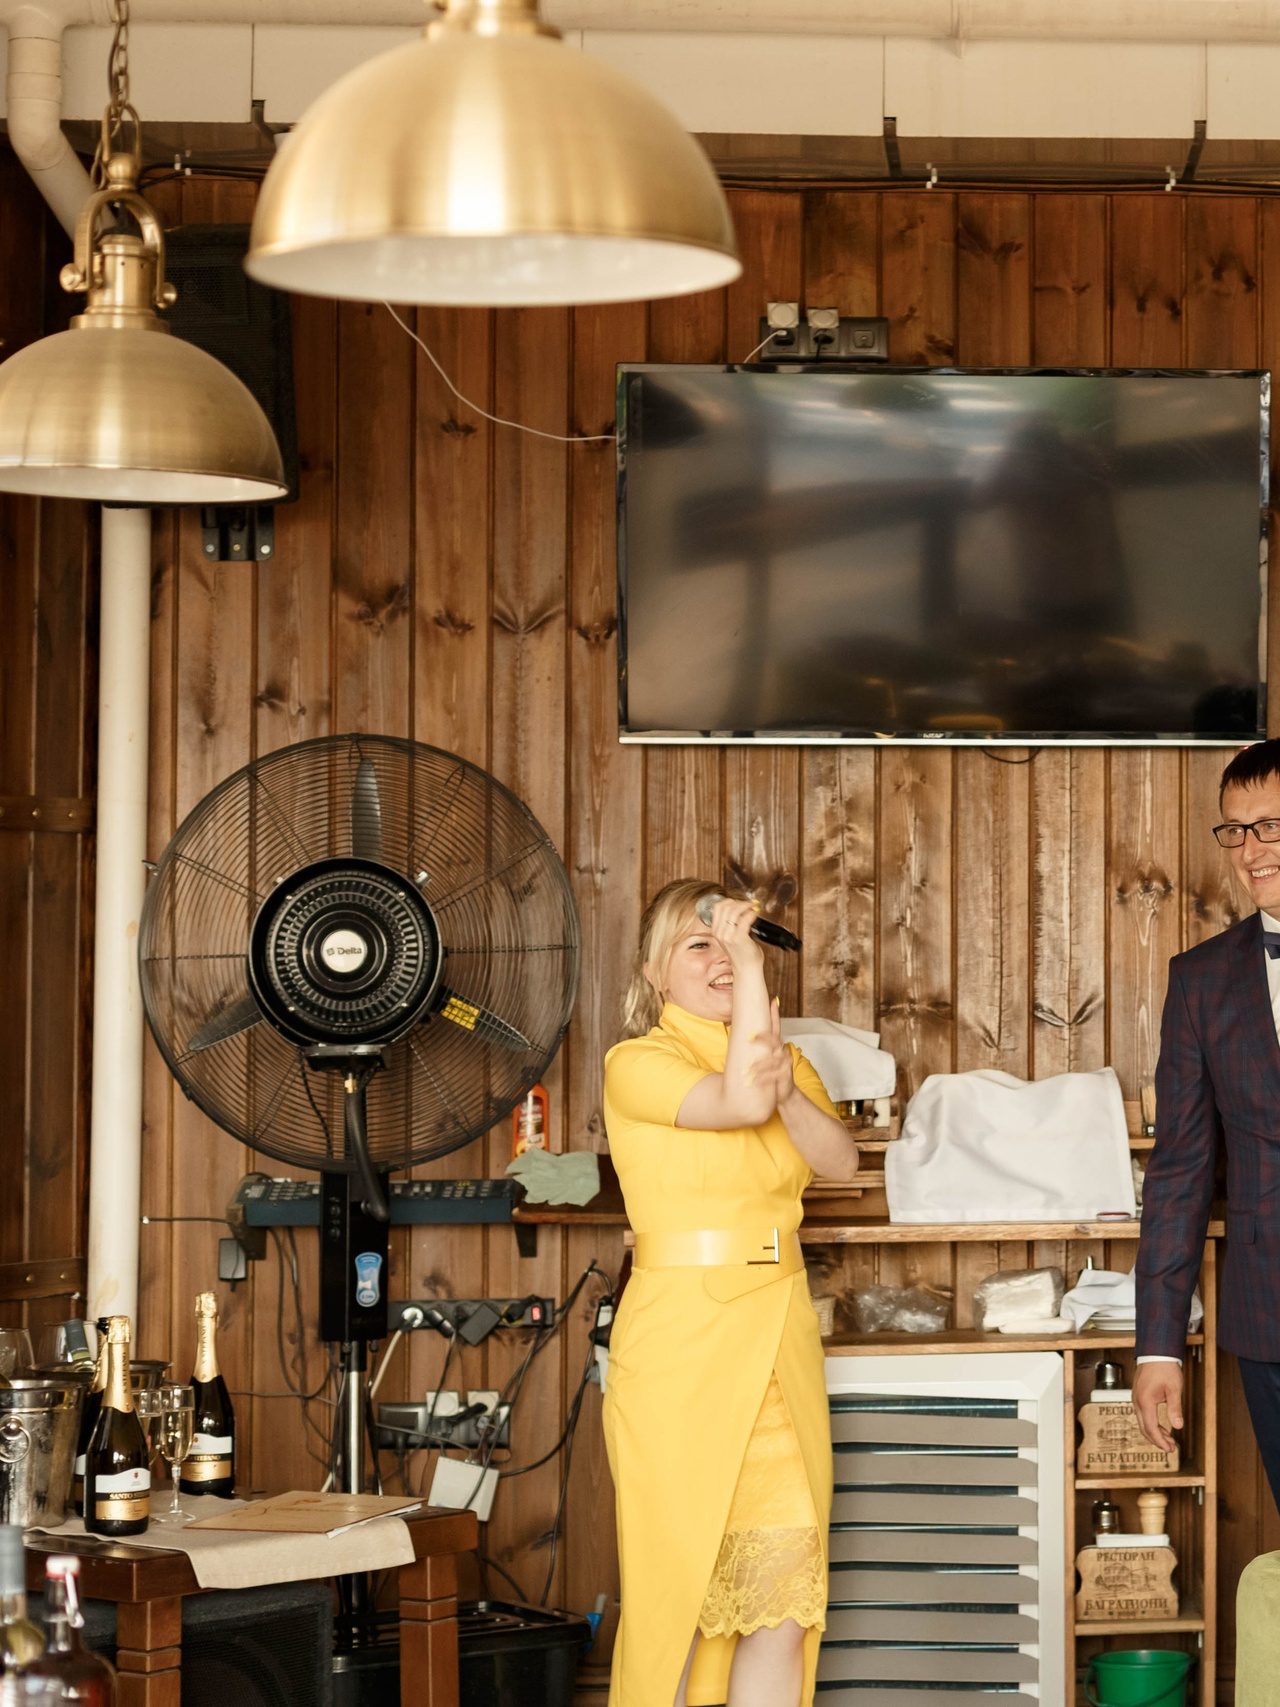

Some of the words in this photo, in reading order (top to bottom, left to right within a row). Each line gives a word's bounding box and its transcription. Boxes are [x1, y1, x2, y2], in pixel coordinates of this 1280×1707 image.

[337, 947, 362, 955] Delta
[1099, 1406, 1137, 1416] РЕСТО
[1087, 1452, 1169, 1463] БАГРАТИОНИ
[1096, 1551, 1155, 1561] РЕСТОРАН
[1085, 1598, 1167, 1610] БАГРАТИОНИ
